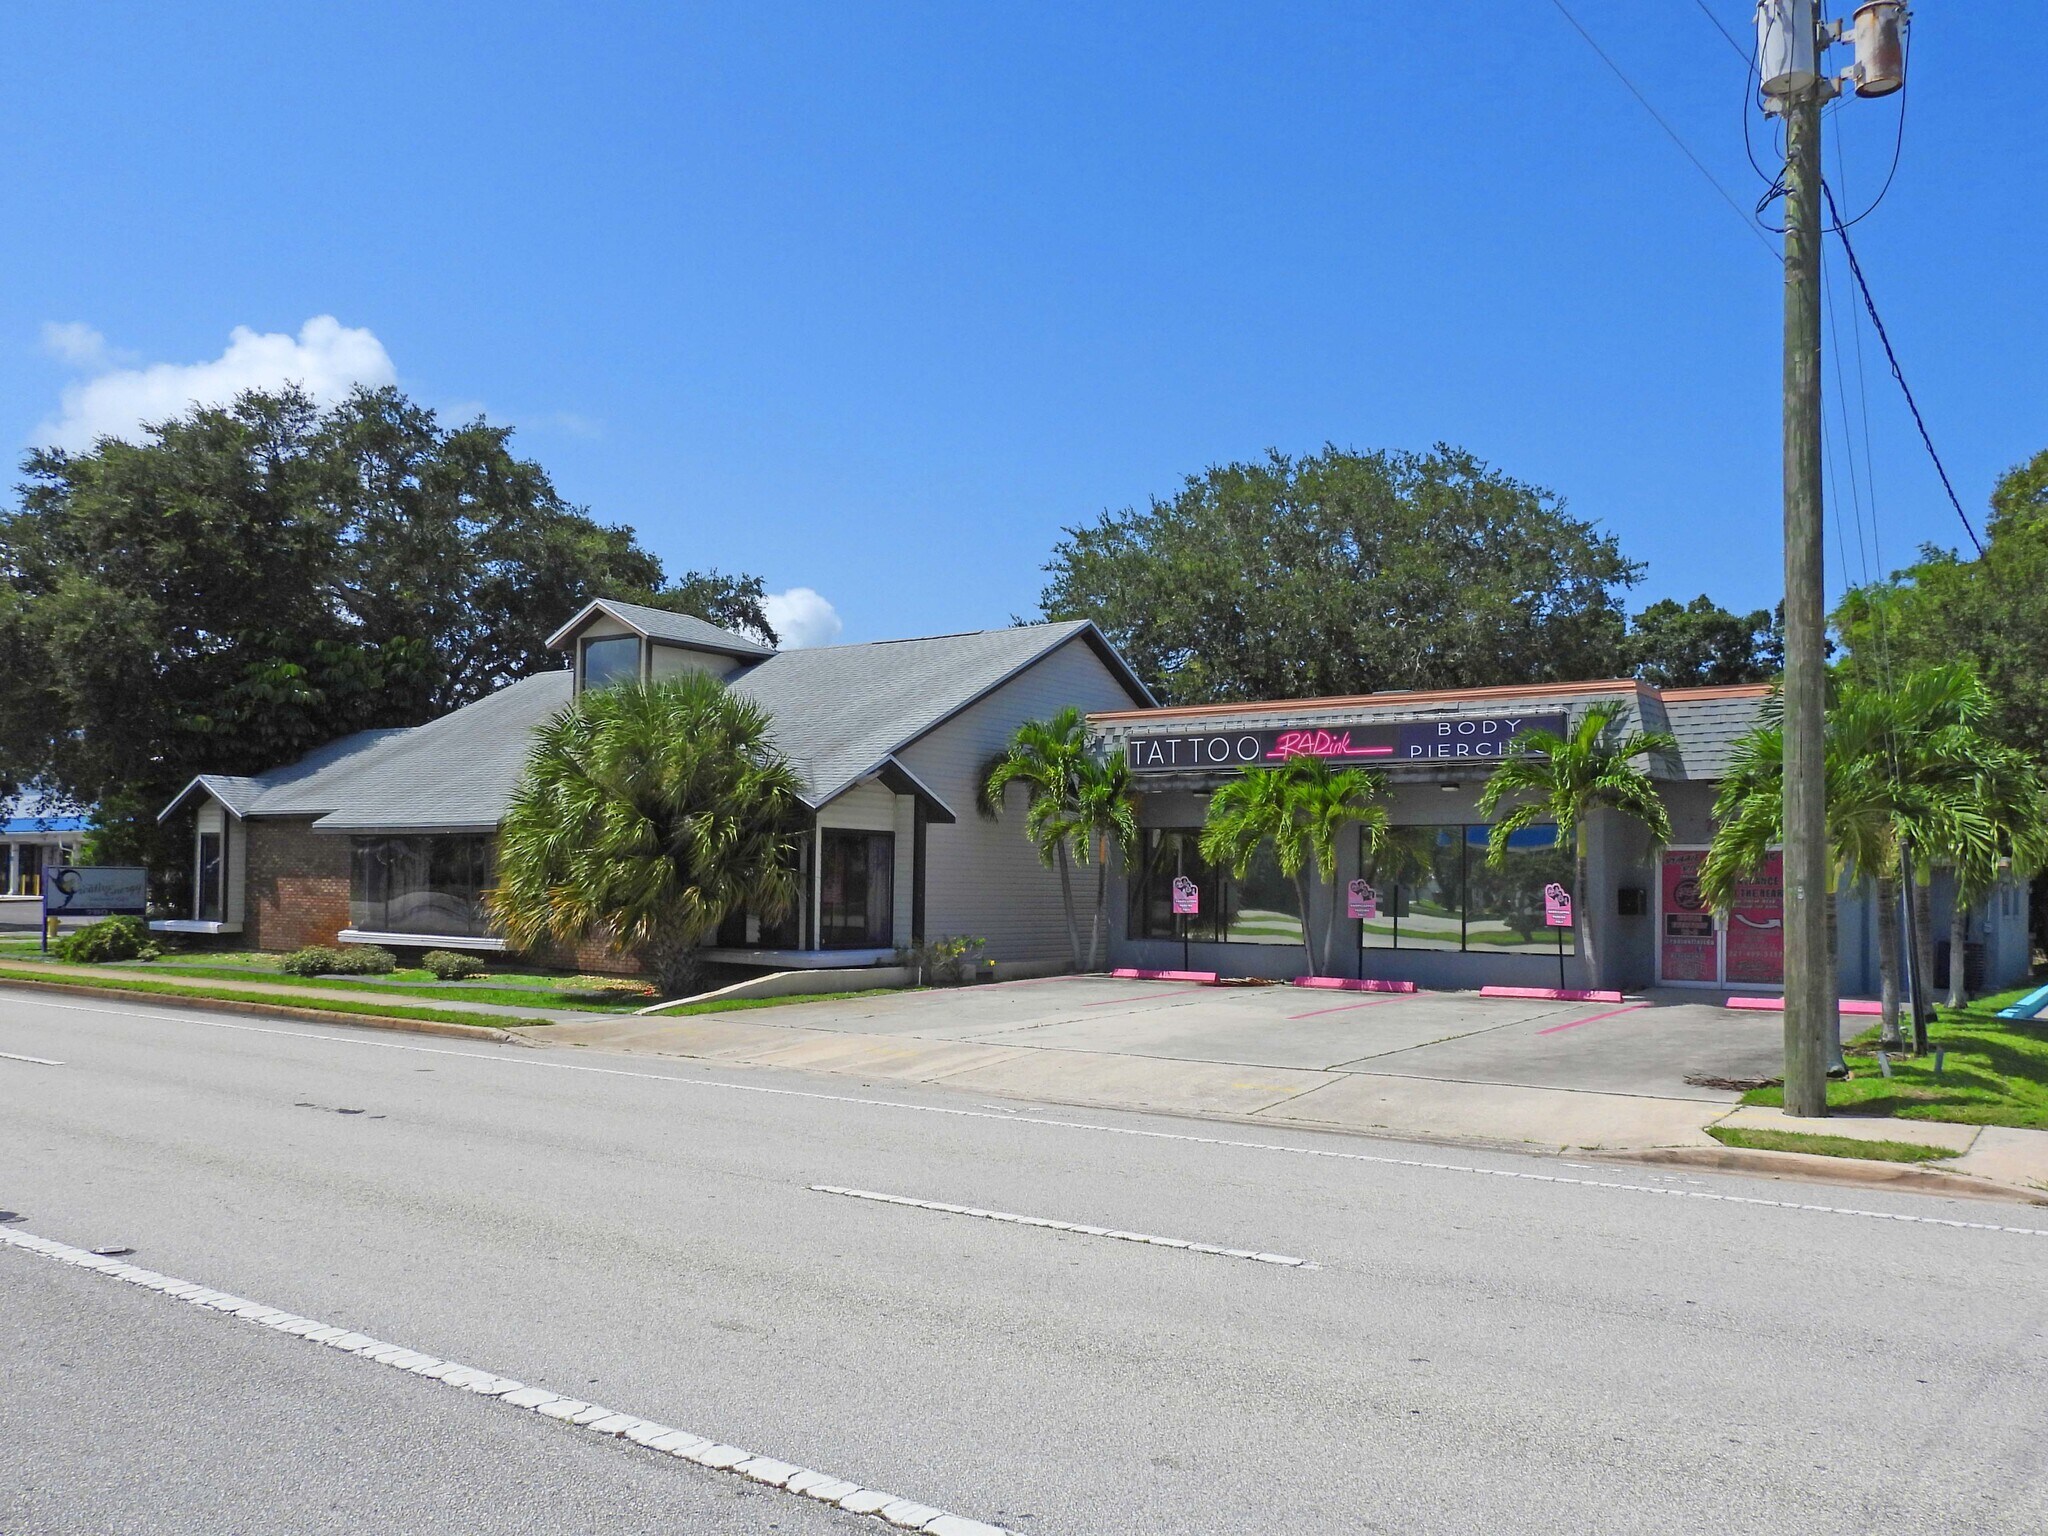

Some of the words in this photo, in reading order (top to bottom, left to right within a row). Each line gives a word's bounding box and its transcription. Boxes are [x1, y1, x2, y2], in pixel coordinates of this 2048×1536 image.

[1438, 719, 1522, 736] BODY
[1131, 736, 1260, 766] TATTOO
[1410, 742, 1545, 758] PIERCIN
